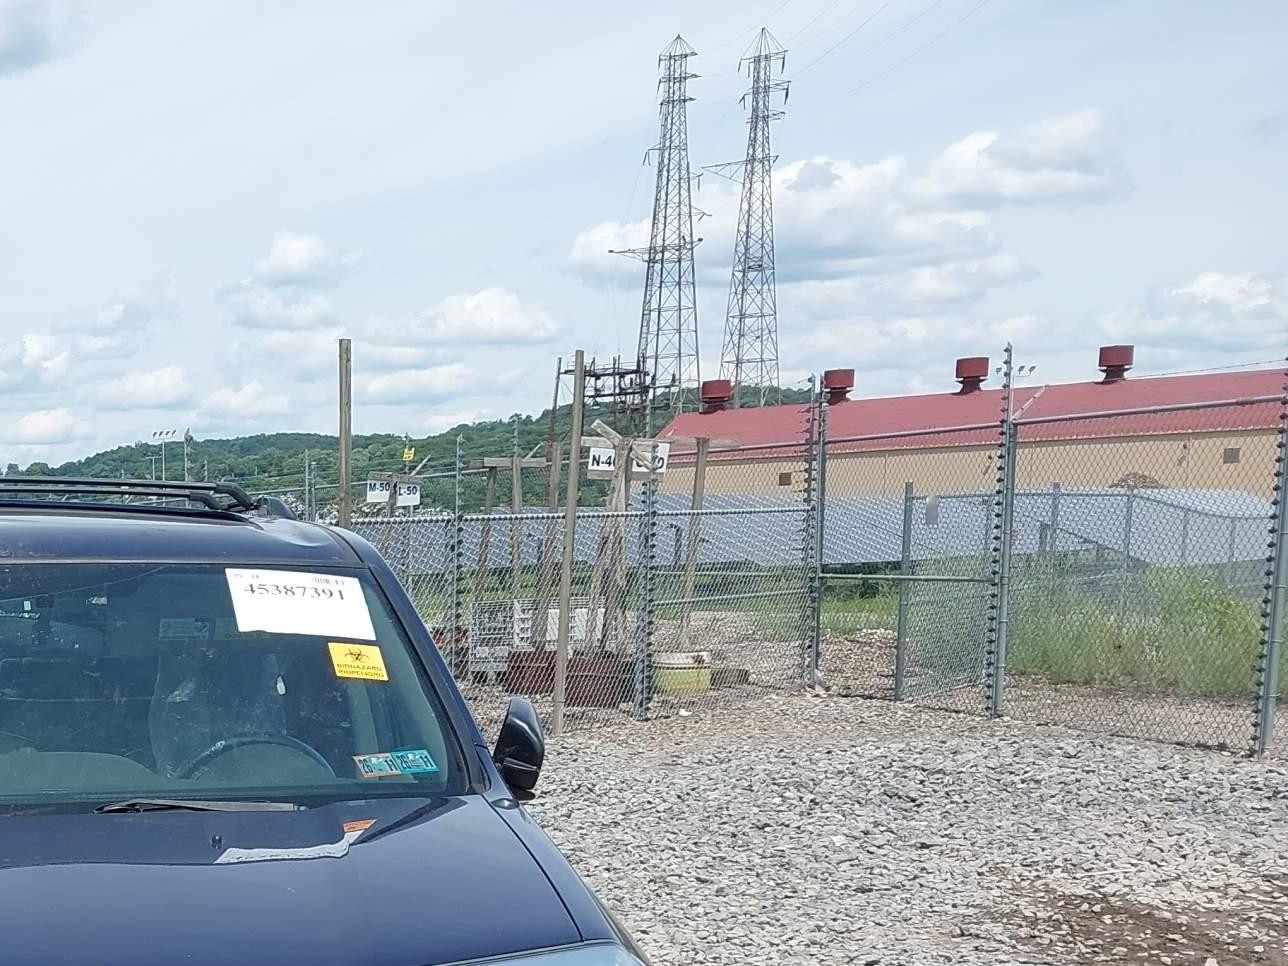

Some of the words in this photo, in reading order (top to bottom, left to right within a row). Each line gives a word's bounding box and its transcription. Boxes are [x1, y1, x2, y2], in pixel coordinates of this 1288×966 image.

[591, 454, 616, 468] N-4
[368, 482, 391, 493] M-50
[398, 485, 418, 496] L-50
[243, 583, 345, 601] 45387391
